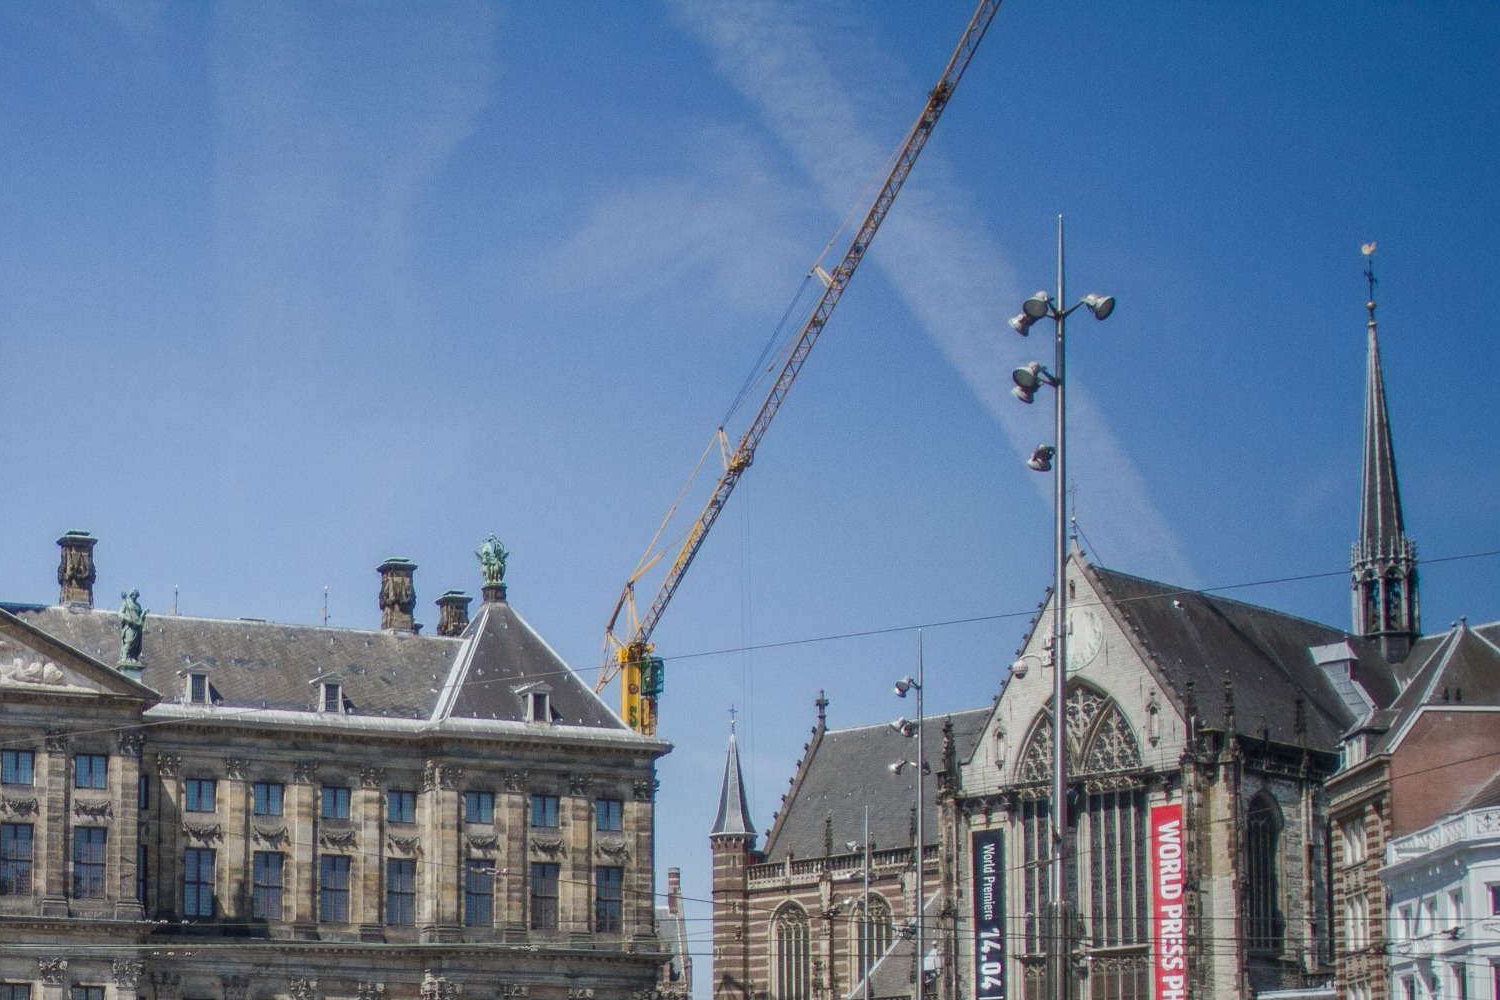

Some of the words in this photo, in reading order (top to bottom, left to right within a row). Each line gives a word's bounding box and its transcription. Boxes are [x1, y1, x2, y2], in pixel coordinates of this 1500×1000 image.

[982, 843, 996, 874] World
[1158, 819, 1182, 900] WORLD
[983, 875, 996, 921] Premiere
[980, 927, 1002, 990] 14.04
[1161, 905, 1184, 971] PRESS
